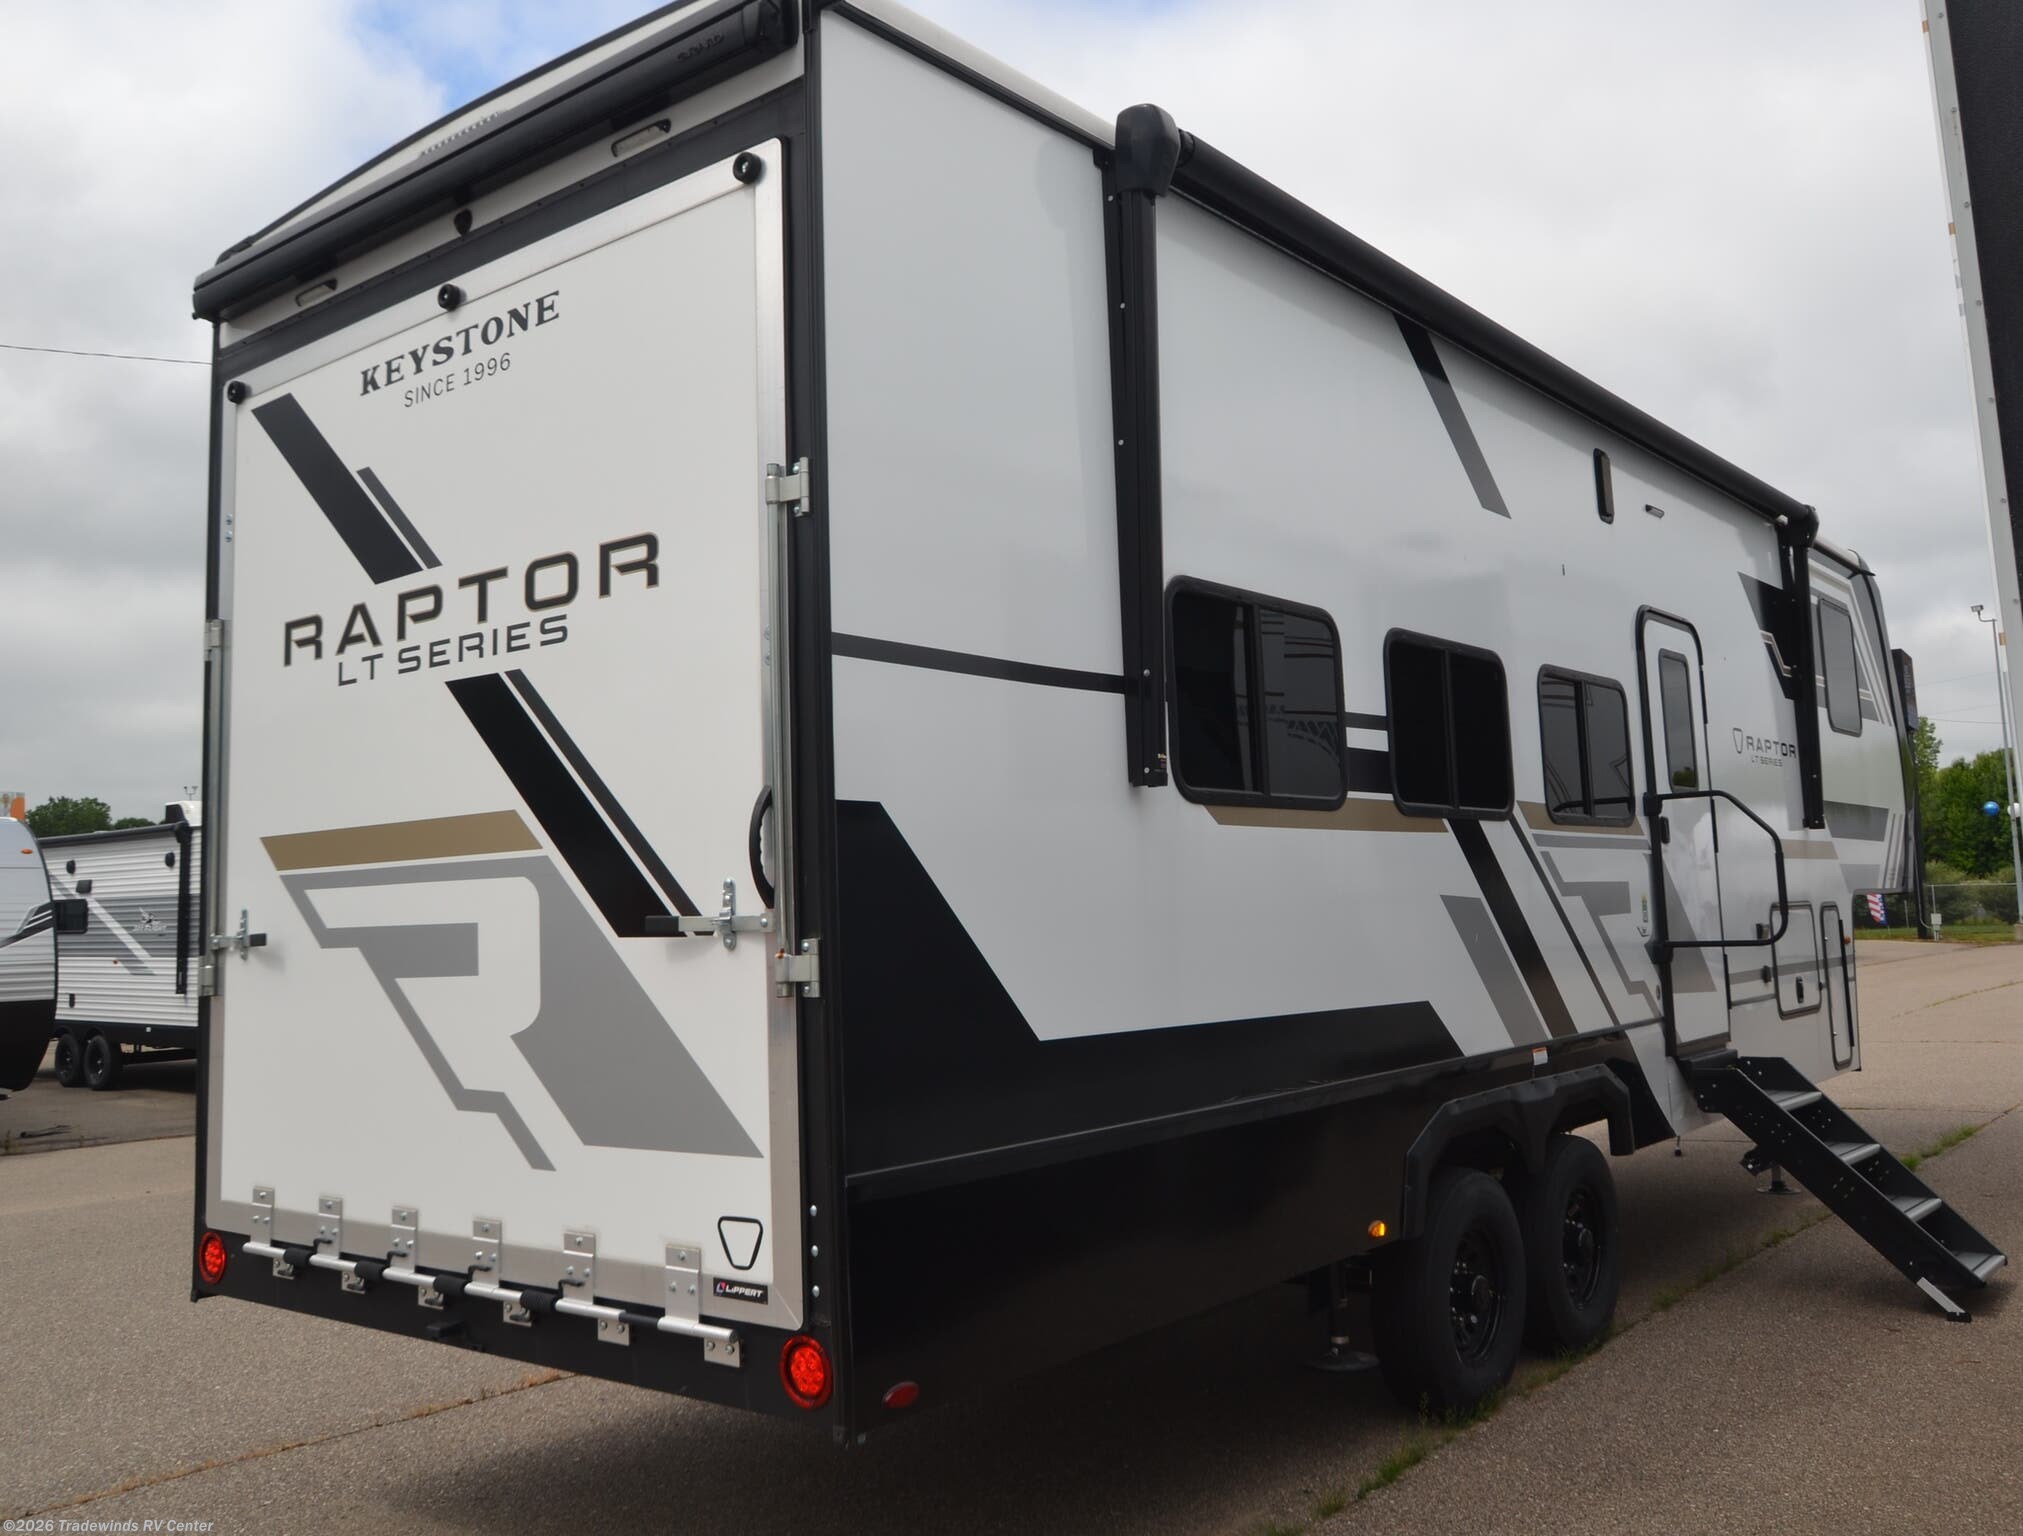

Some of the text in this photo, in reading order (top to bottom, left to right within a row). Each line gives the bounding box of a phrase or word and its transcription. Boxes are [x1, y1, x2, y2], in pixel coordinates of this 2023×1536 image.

[360, 290, 560, 397] KEYSTONE
[404, 352, 511, 408] SINCE 1996
[283, 531, 660, 668] RAPTOR
[338, 614, 569, 687] LT SERIES
[1746, 735, 1797, 759] RAPTOR
[1760, 756, 1783, 767] SERIES
[725, 1284, 764, 1298] LIPPERT
